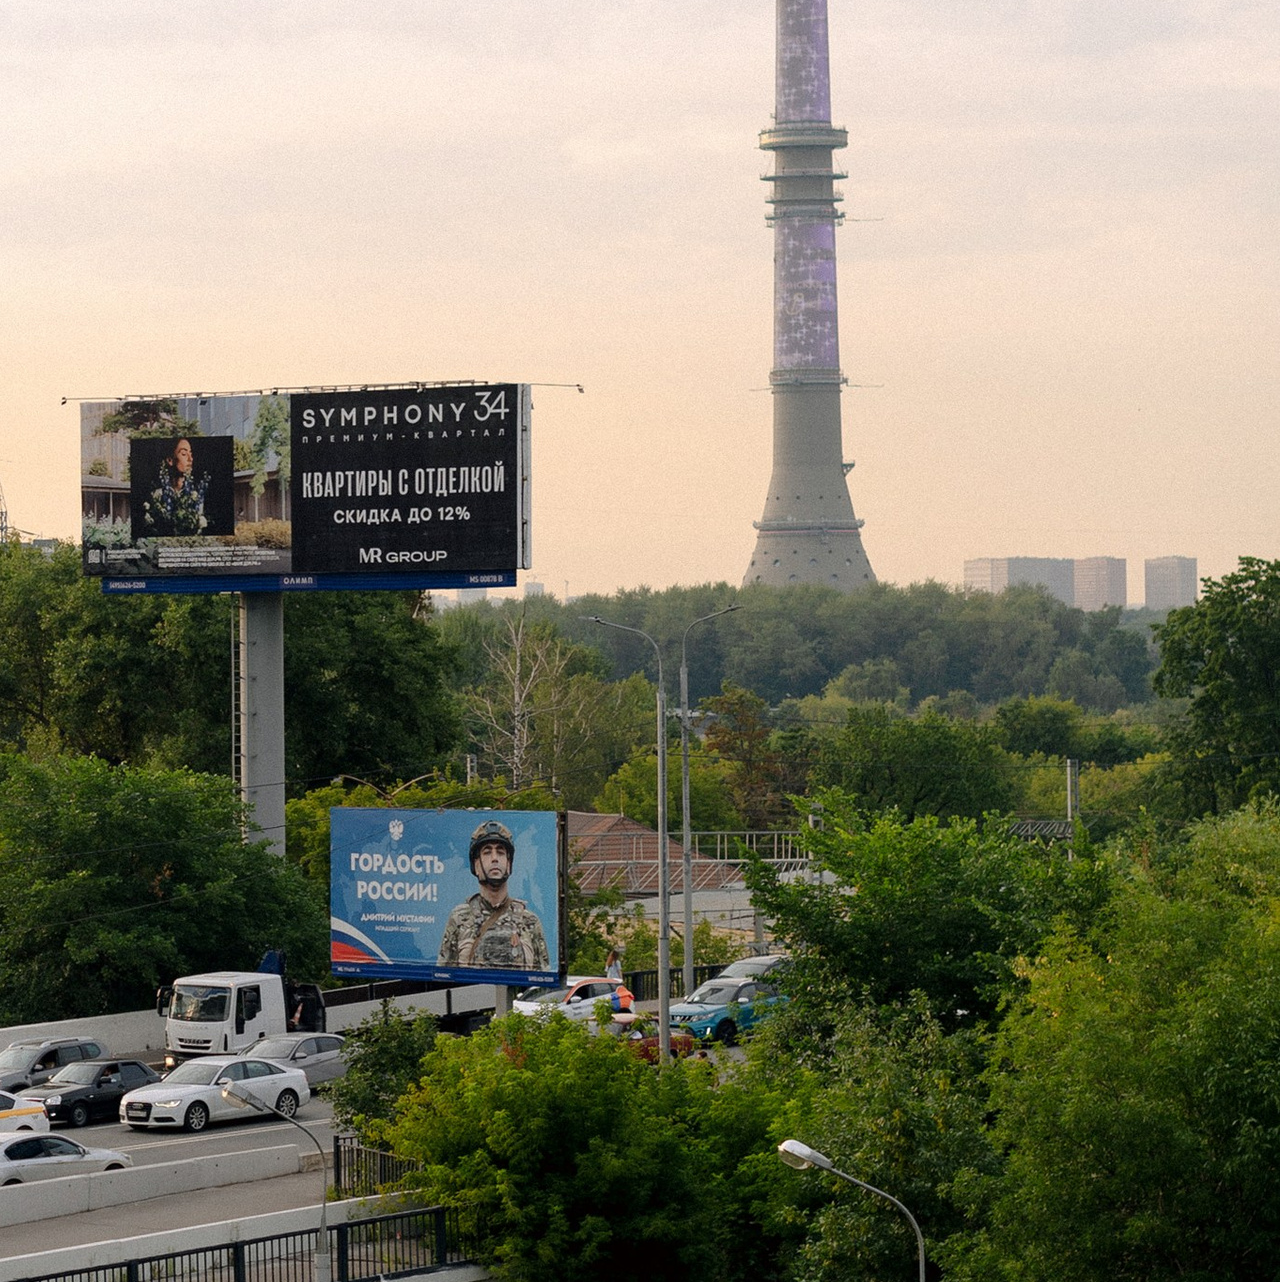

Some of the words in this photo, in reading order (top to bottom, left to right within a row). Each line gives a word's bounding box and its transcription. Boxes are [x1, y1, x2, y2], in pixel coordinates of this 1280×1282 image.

[302, 402, 466, 428] SYMPHONY
[473, 390, 510, 422] 34
[302, 428, 505, 444] ПРЕМИУМ-КВАРТАЛ
[302, 469, 392, 499] КВАРТИРЫ
[398, 468, 409, 496] С
[414, 460, 505, 497] ОТДЕЛКОЙ
[333, 508, 402, 525] СКИДКА
[408, 507, 433, 524] ДО
[438, 506, 471, 521] 12%
[359, 547, 382, 564] MR
[386, 550, 448, 563] GROUP
[283, 576, 313, 585] ОЛИМП
[350, 853, 444, 875] ГОРДОСТЬ
[356, 880, 438, 902] РОССИИ!
[360, 911, 395, 922] ДМИТРИЙ
